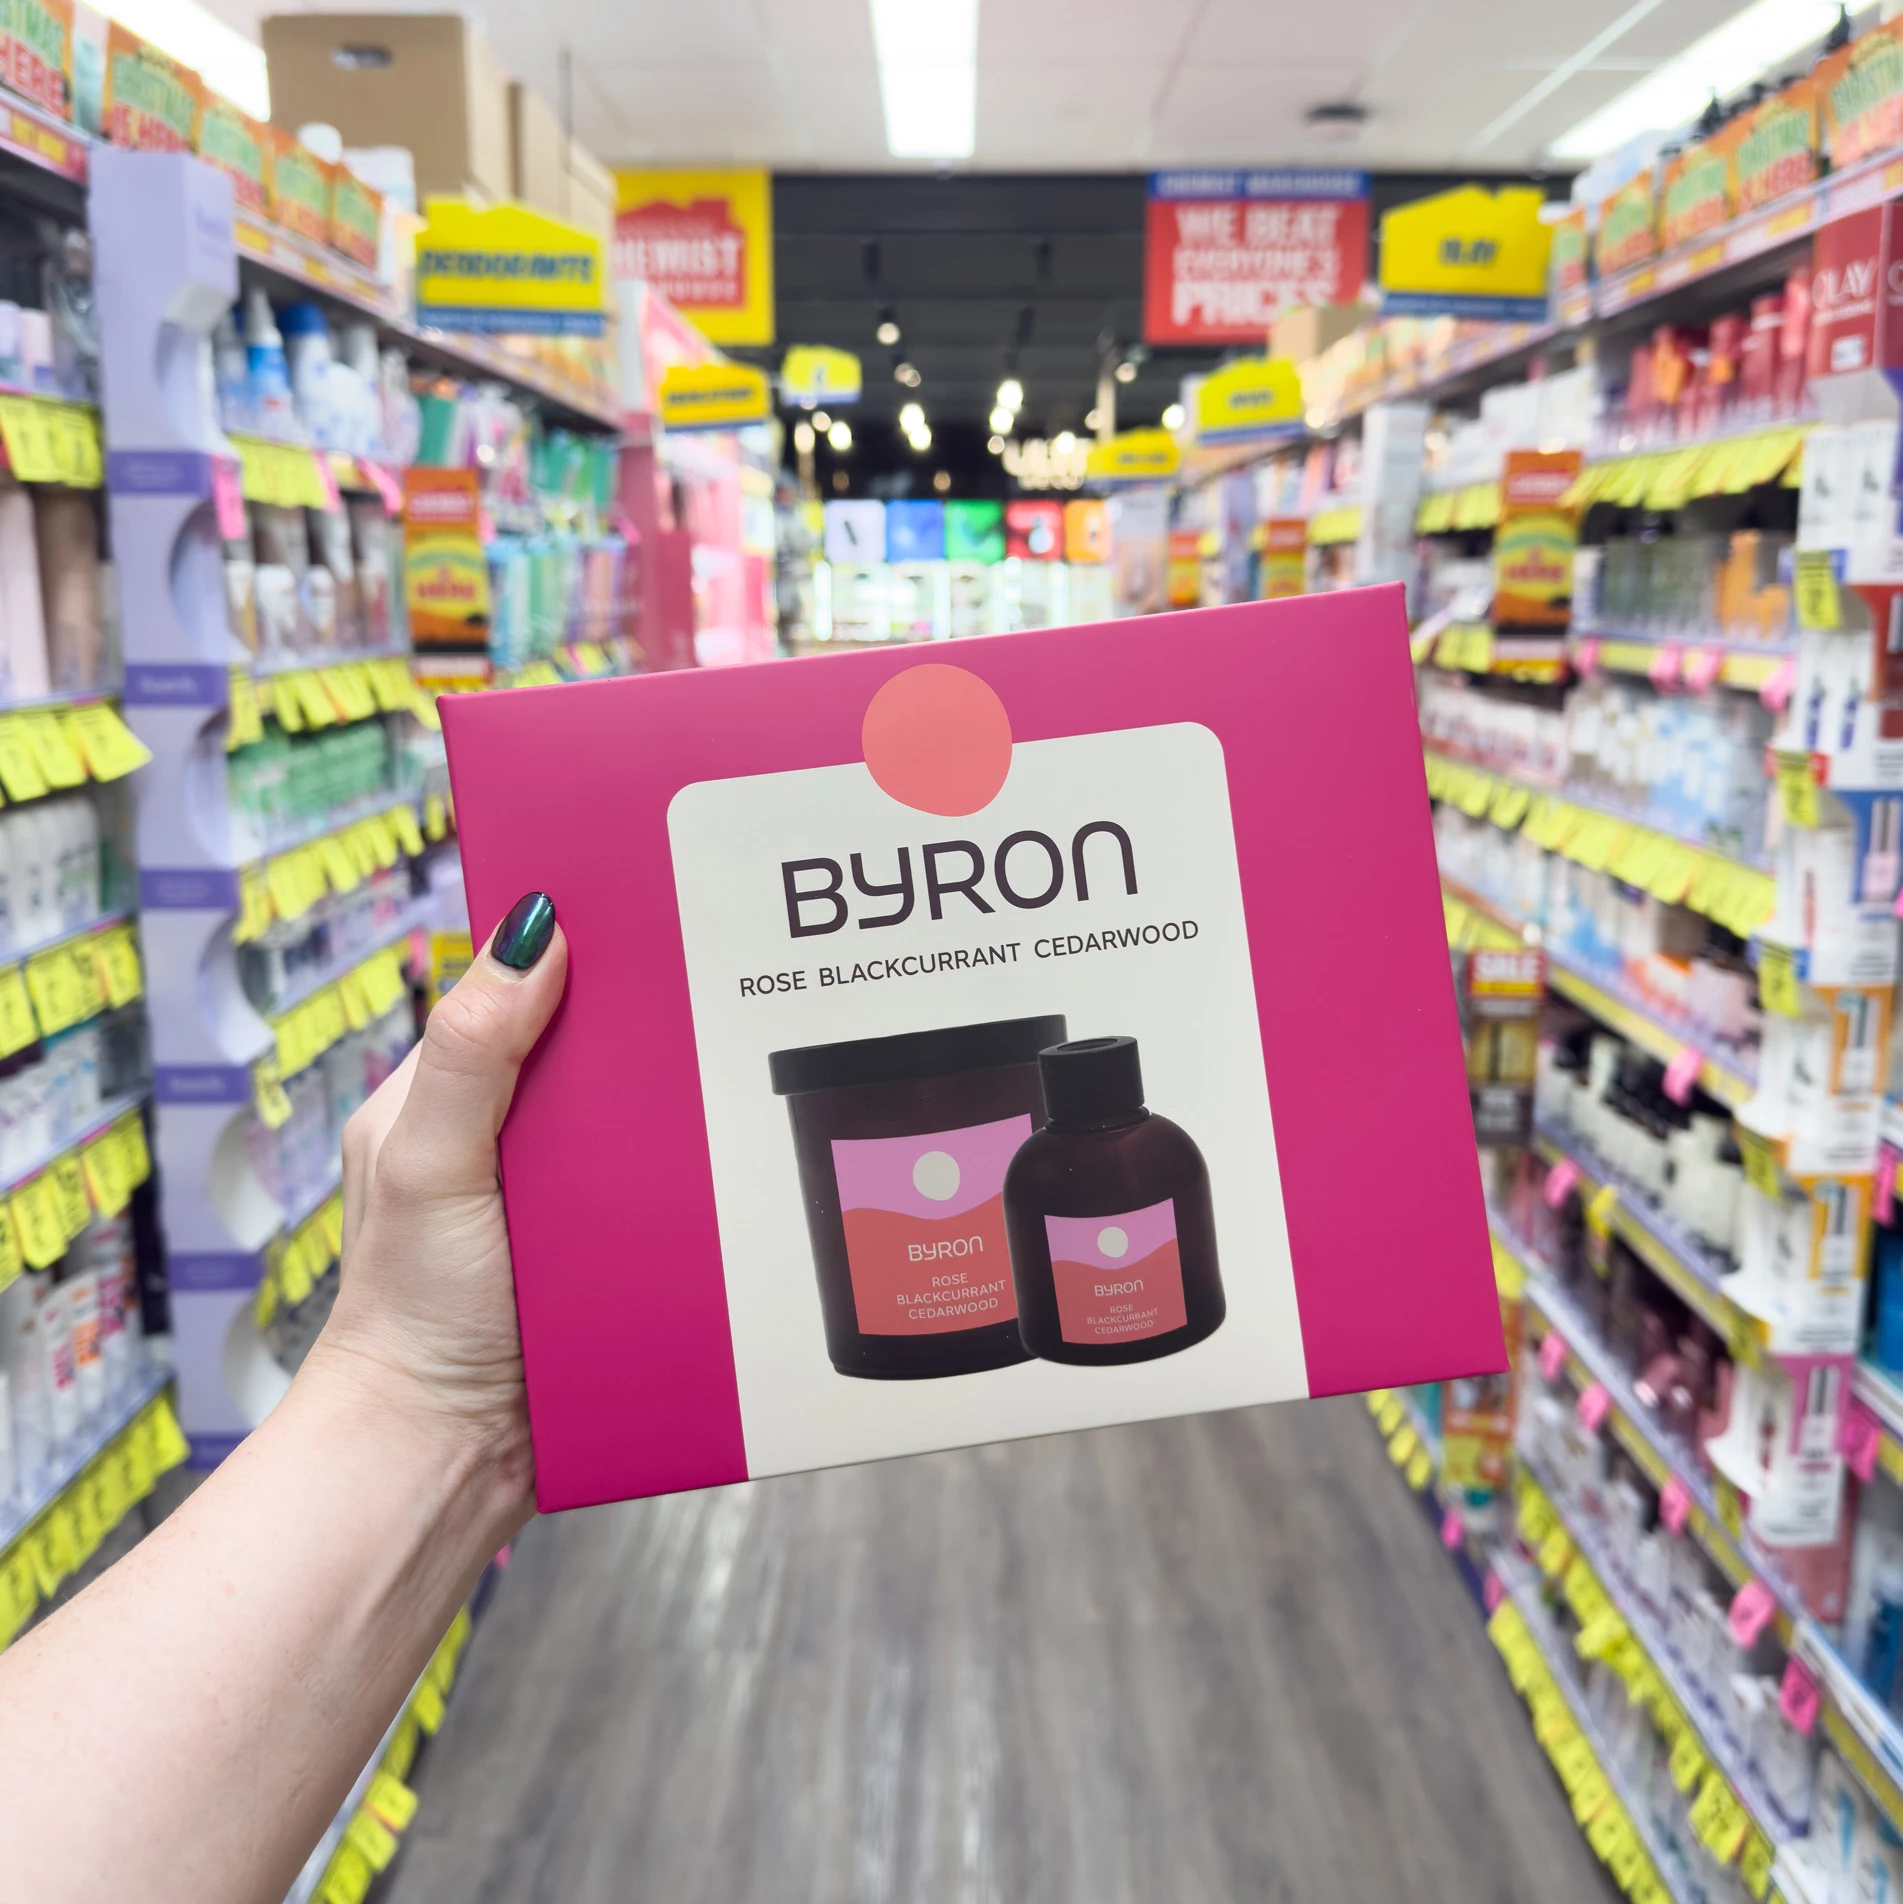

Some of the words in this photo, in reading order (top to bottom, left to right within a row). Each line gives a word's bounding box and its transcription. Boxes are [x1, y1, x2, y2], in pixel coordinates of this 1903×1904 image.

[1174, 205, 1236, 244] WE
[1245, 205, 1342, 245] BEAT
[781, 820, 1139, 939] BYRON
[739, 970, 808, 998] ROSE
[818, 942, 1022, 988] BLACKCURRANT
[1034, 919, 1200, 959] CEDARWOOD
[908, 1235, 984, 1262] BYRON
[931, 1272, 969, 1288] ROSE
[1094, 1279, 1144, 1297] BYRON
[896, 1279, 1006, 1305] BLACKCURRANT
[908, 1297, 999, 1320] CEDARWOOD
[1086, 1307, 1159, 1325] BLACKCURRANT
[1109, 1303, 1134, 1314] ROSE
[1094, 1319, 1154, 1334] CEDARWOOD
